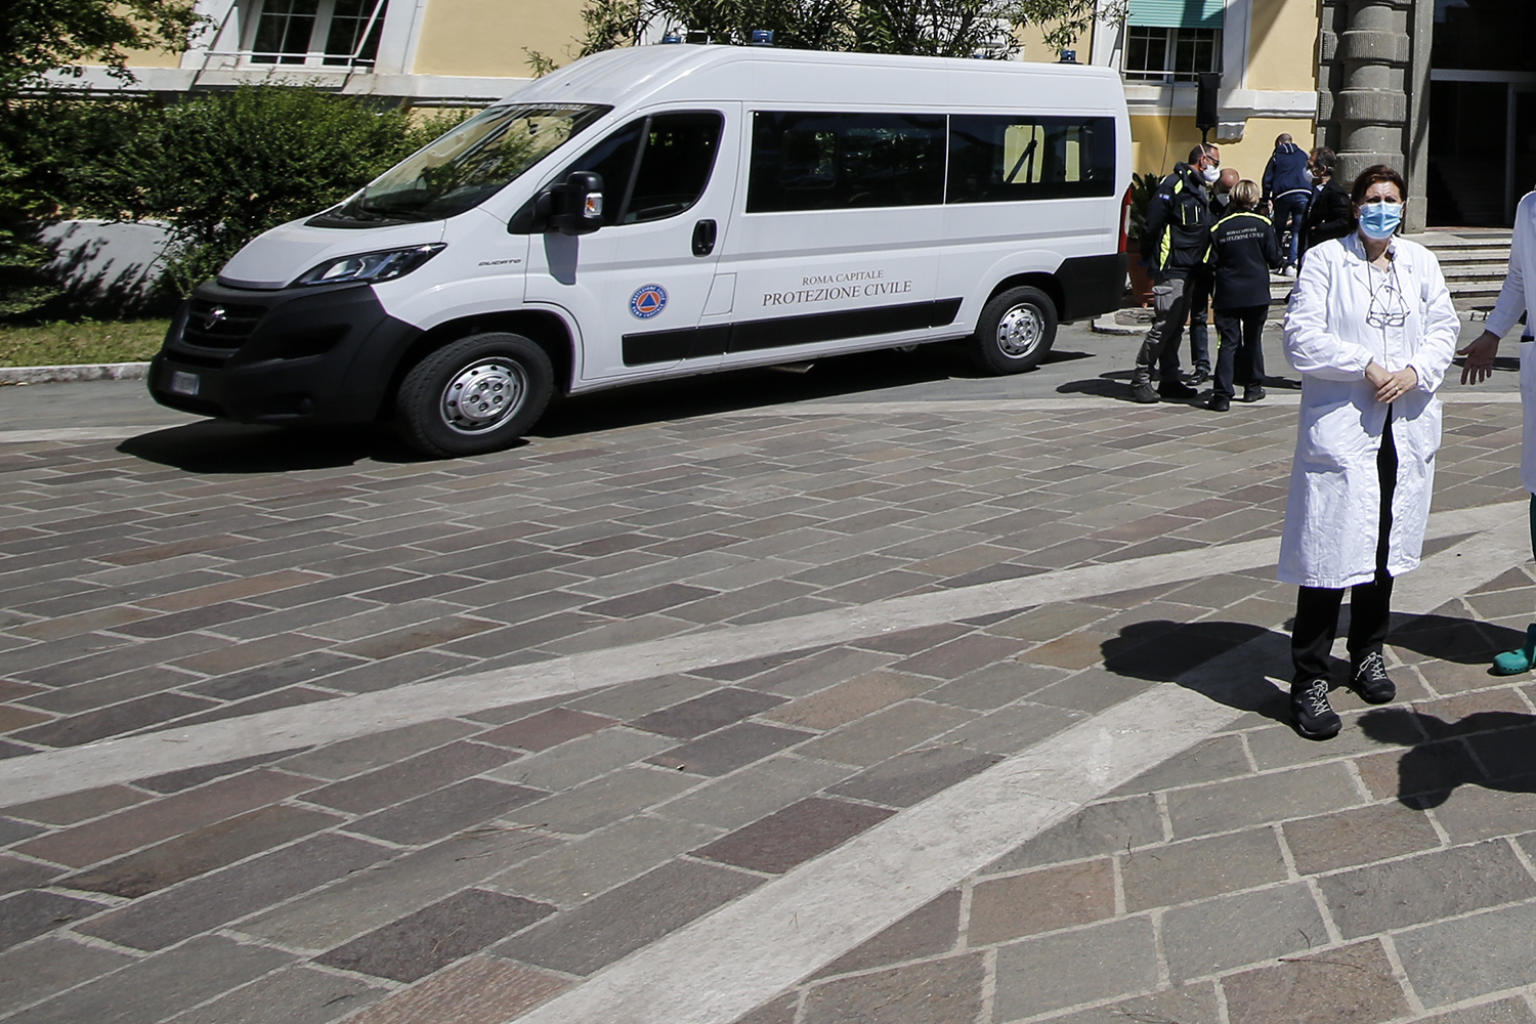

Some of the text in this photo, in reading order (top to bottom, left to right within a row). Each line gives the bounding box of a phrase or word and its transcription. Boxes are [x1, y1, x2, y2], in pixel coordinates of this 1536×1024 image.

[802, 270, 884, 286] ROMA CAPITALE
[763, 280, 912, 306] PROTEZIONE CIVILE
